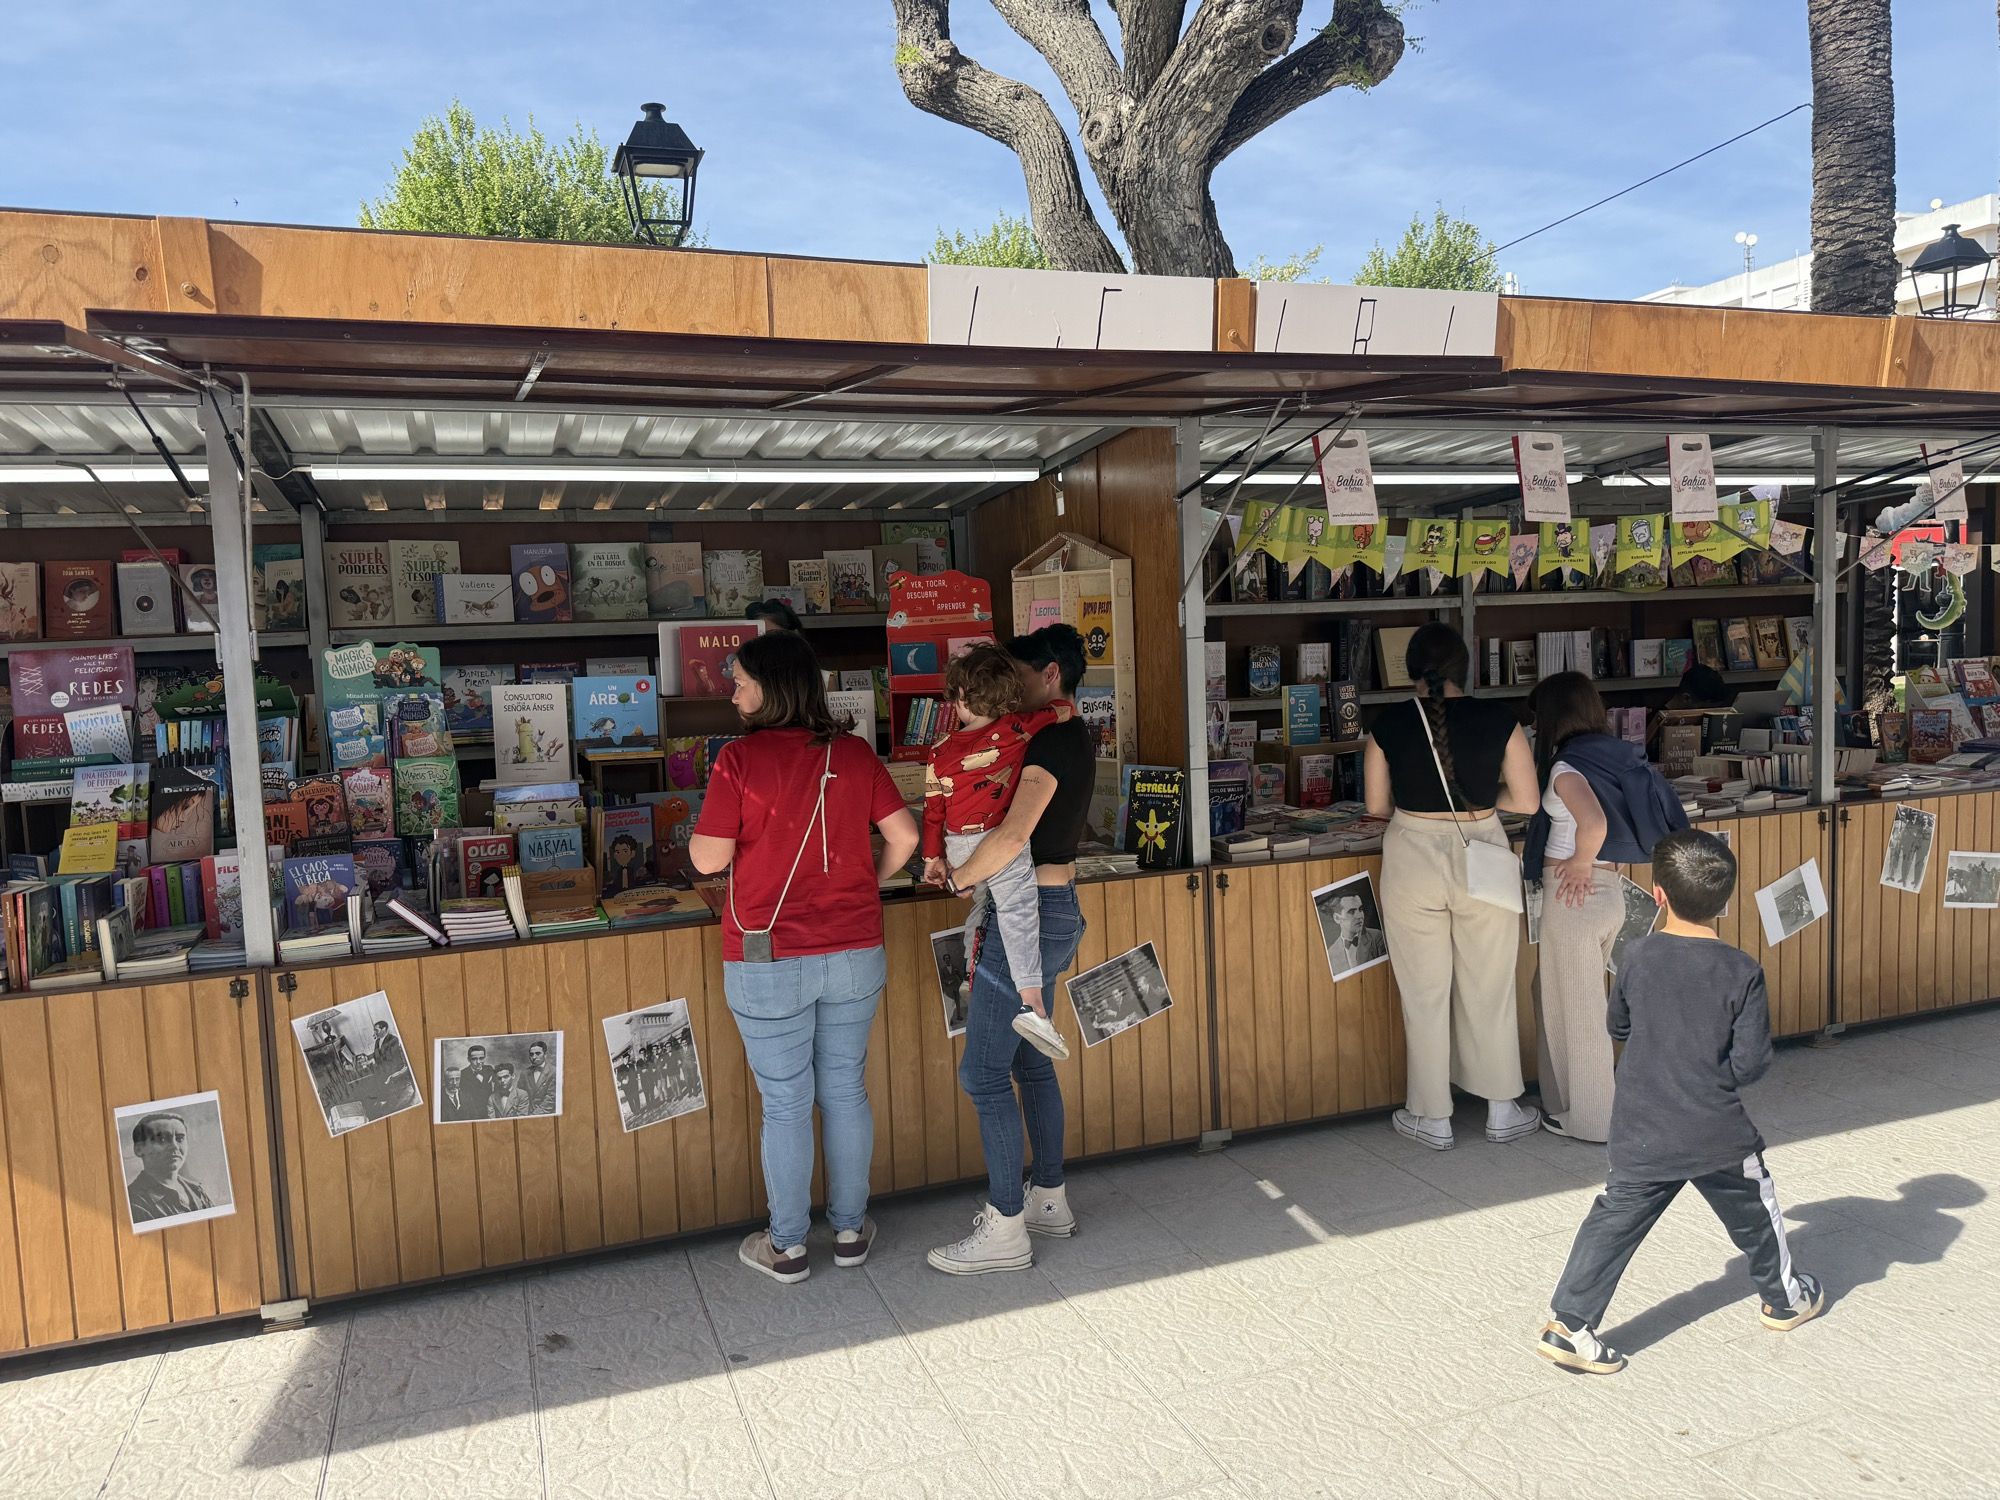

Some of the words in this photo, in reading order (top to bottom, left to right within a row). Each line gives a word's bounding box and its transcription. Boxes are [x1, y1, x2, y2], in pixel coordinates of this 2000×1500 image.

[340, 552, 384, 564] SUPER
[338, 564, 388, 575] PODERES
[406, 560, 447, 572] SUPER
[831, 562, 867, 576] AMISTAD
[460, 580, 496, 589] Valiente
[910, 581, 924, 589] VER,
[926, 579, 948, 588] TOCAR,
[906, 590, 938, 599] DESCUBRIR
[937, 601, 966, 610] APRENDER
[699, 635, 741, 649] MALO
[334, 649, 366, 665] MAGIC
[331, 657, 376, 677] ANIMALS
[1252, 660, 1278, 669] BROWN
[69, 680, 125, 696] REDES
[464, 678, 490, 688] PIRATA
[504, 693, 552, 701] CONSULTORIO
[503, 703, 531, 712] SEÑORA
[1082, 700, 1114, 713] BUSCAR
[1298, 699, 1306, 713] 5
[70, 714, 121, 730] INVISIBLE
[23, 723, 65, 735] REDES
[81, 772, 96, 780] UNA
[97, 770, 128, 779] HISTORIA
[1135, 782, 1180, 794] ESTRELLA
[266, 829, 303, 844] ALOTES
[467, 843, 508, 857] OLGA
[528, 838, 576, 857] NARVAL
[289, 866, 302, 880] EL
[302, 860, 329, 874] CAOS
[294, 876, 307, 888] DE
[307, 870, 332, 885] BECA
